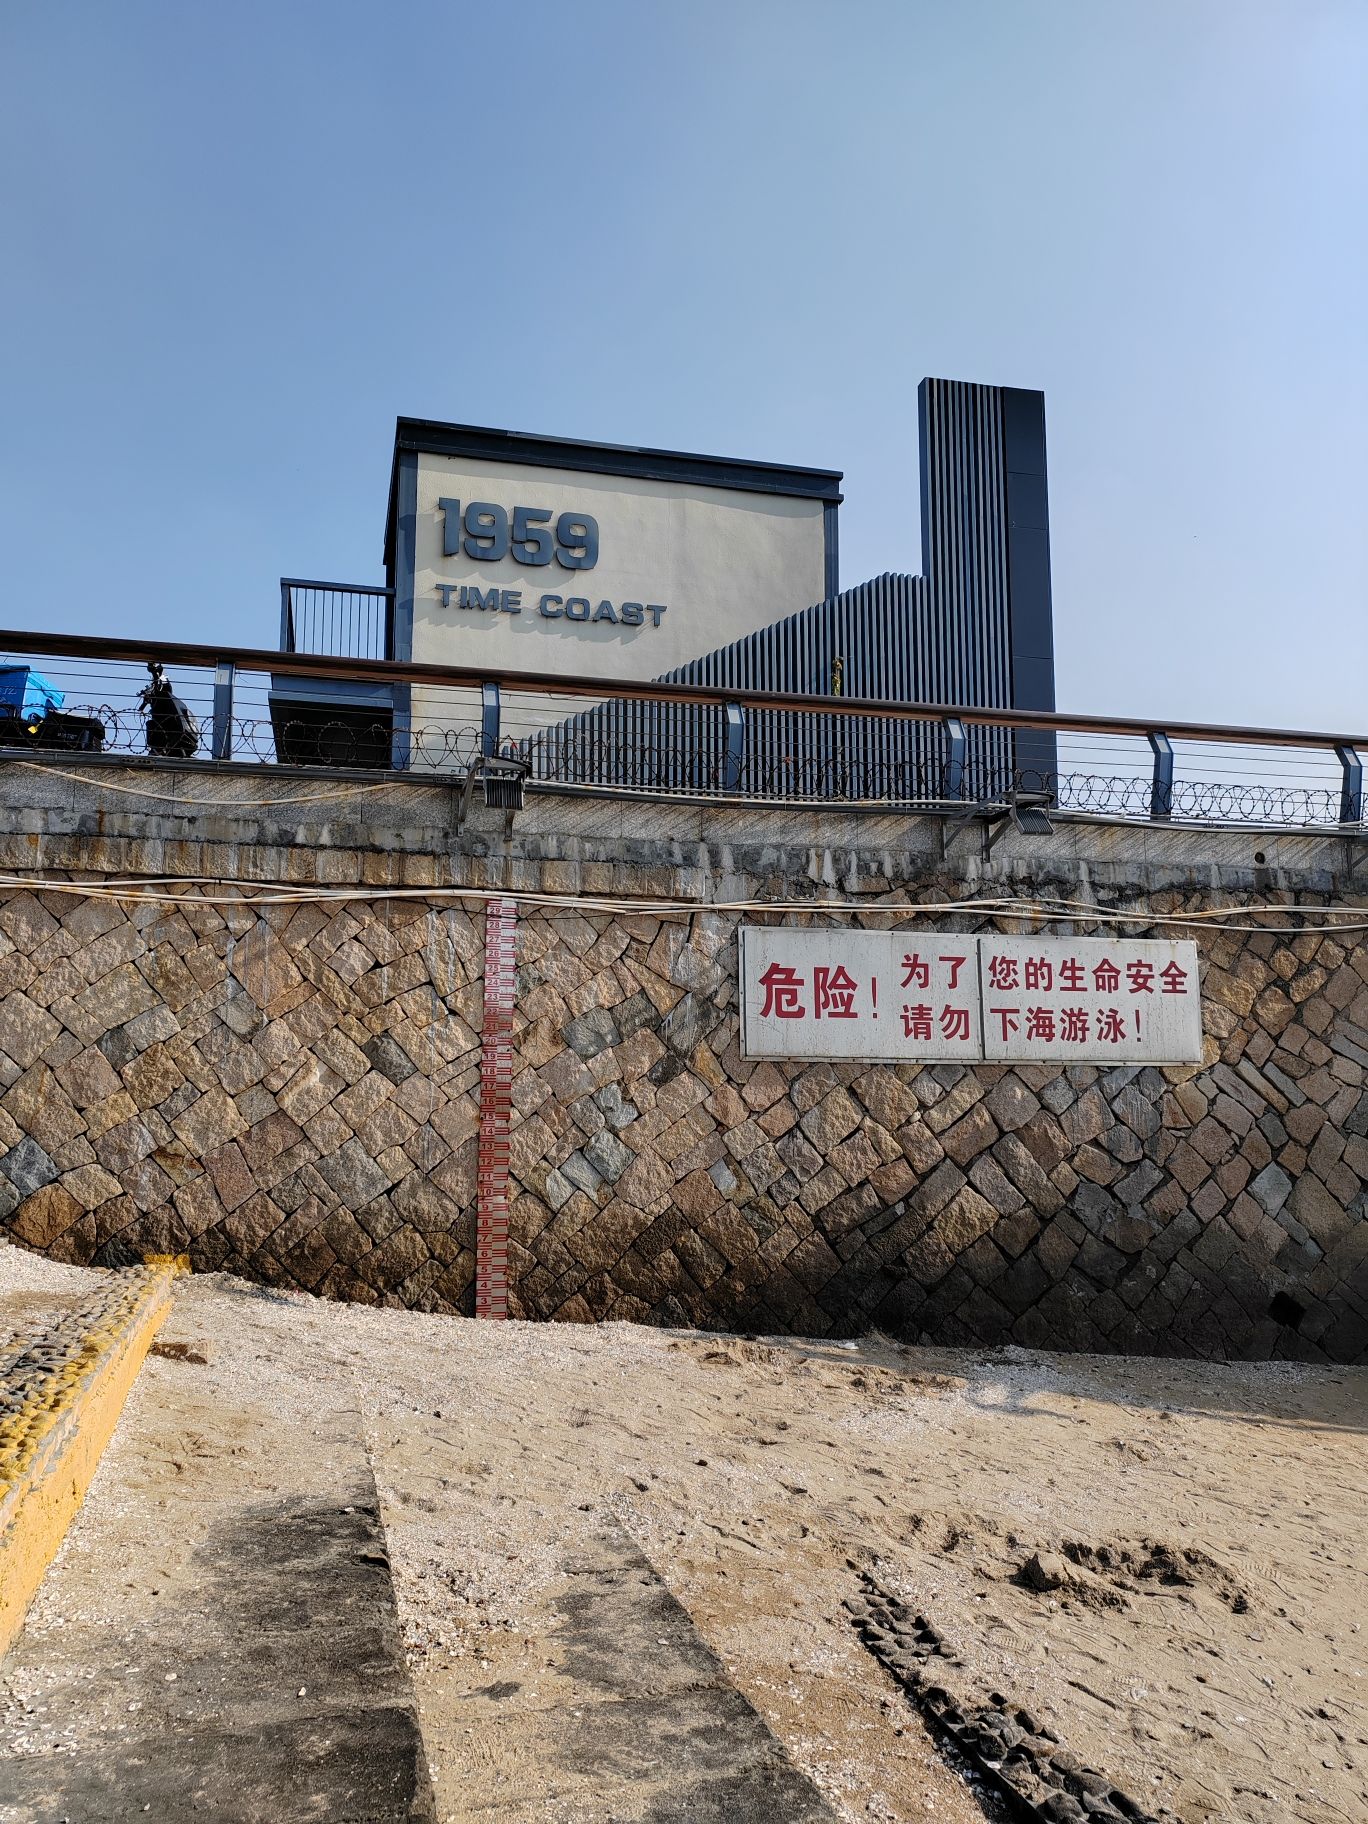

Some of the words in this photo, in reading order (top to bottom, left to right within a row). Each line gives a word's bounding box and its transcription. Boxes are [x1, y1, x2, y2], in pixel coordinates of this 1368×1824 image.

[439, 497, 599, 570] 1959
[435, 583, 523, 614] TIME
[540, 594, 667, 627] COAST
[758, 962, 878, 1020] 危险！
[900, 953, 1188, 995] 为了您的生命安全
[900, 1003, 1143, 1044] 请勿下海游泳！
